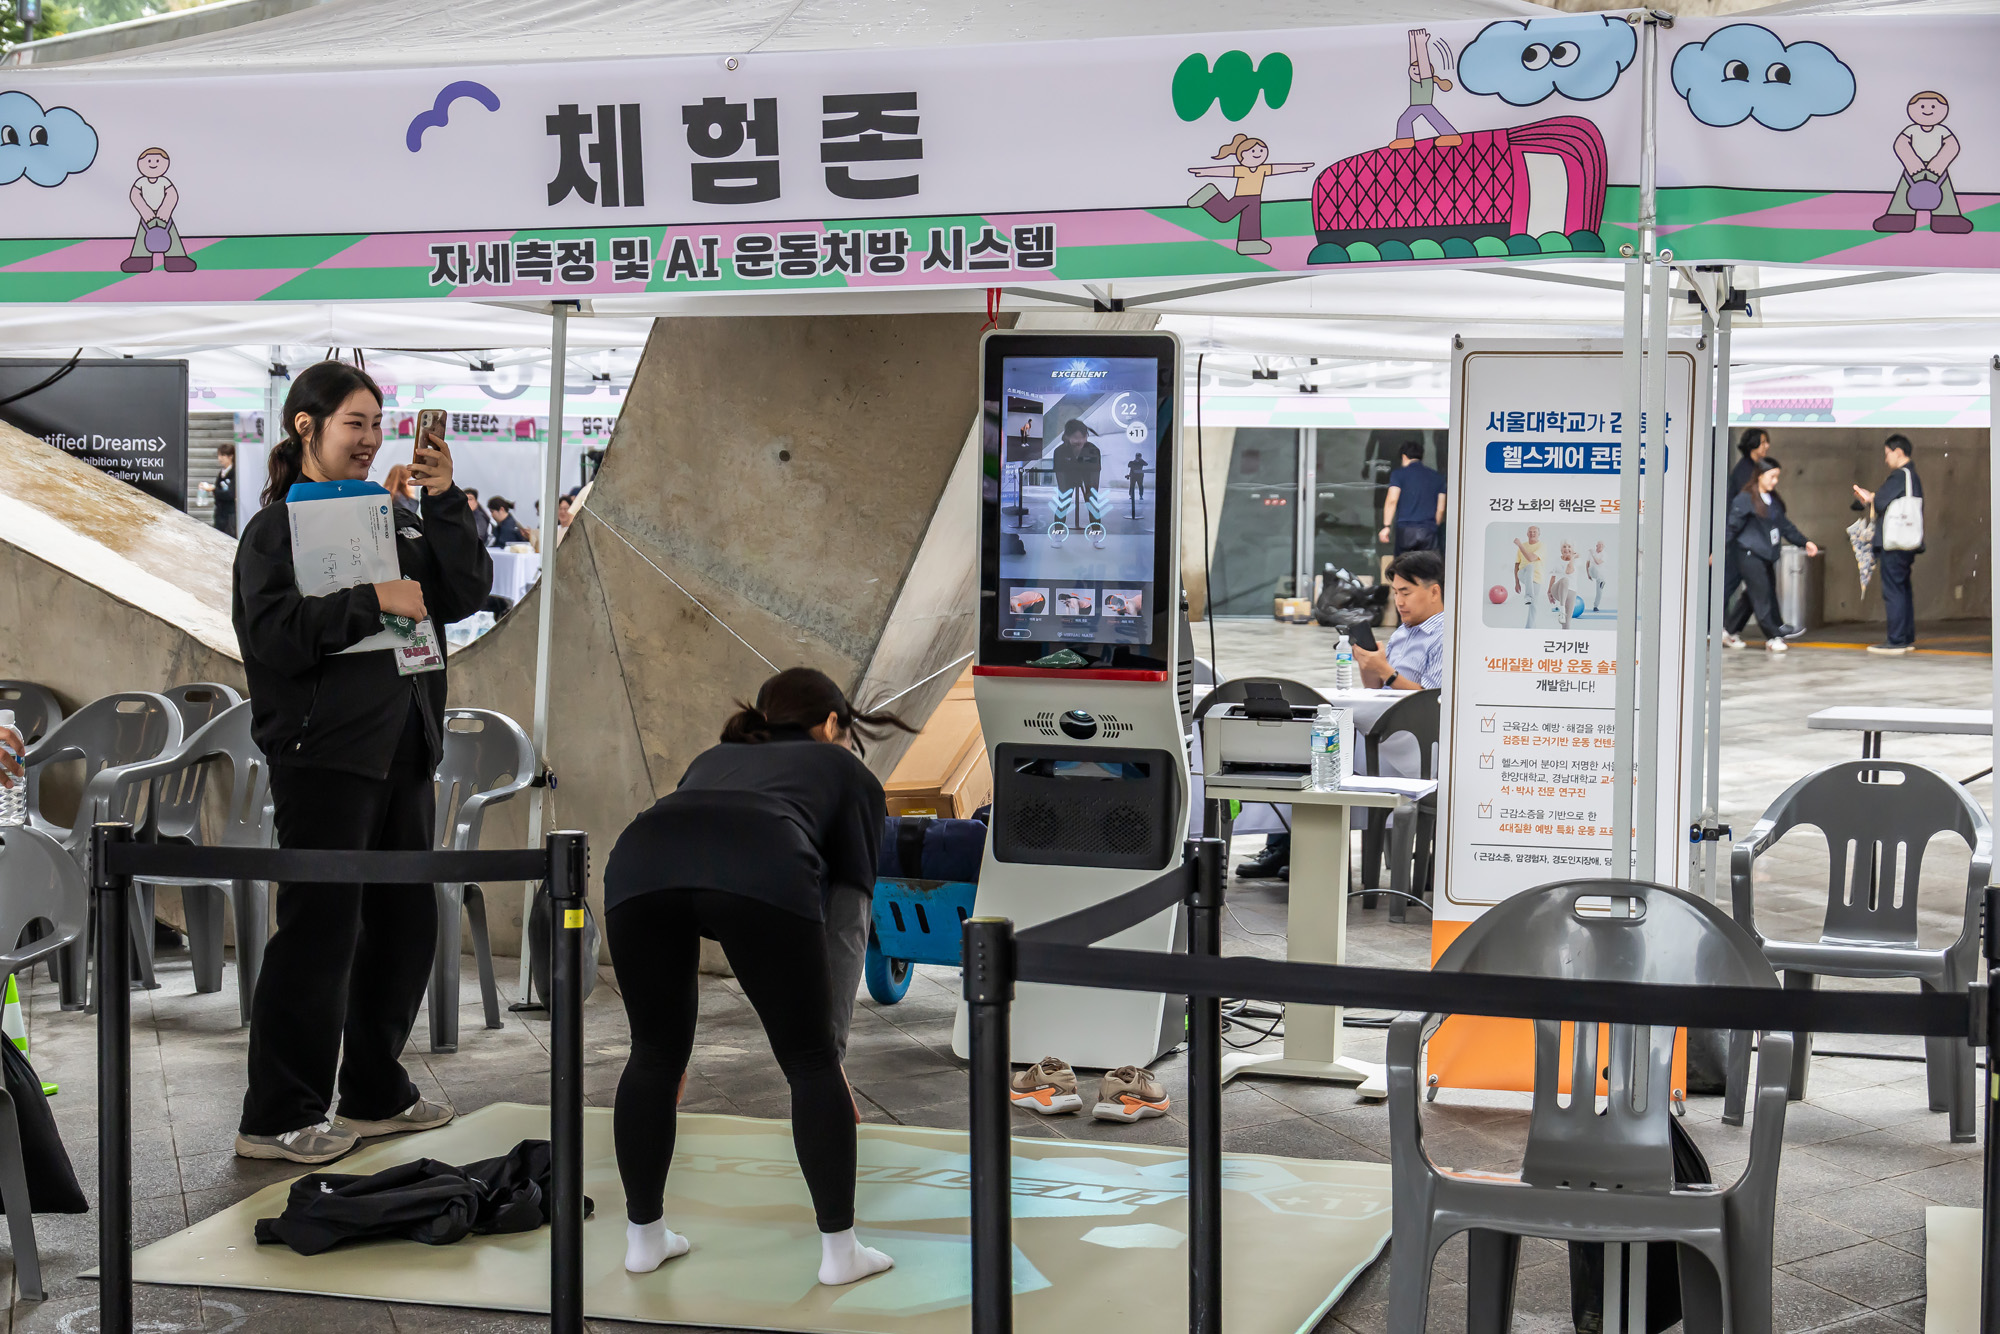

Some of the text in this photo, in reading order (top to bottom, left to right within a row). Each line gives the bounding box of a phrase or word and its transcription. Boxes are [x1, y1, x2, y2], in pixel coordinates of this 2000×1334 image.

[545, 91, 923, 208] 체험존
[431, 225, 1055, 284] 자세측정 및 AI 운동처방 시스템
[1121, 404, 1137, 415] 22
[1486, 411, 1605, 433] 서울대학교가
[39, 434, 87, 449] tified
[121, 458, 133, 469] by
[135, 458, 164, 467] YEKKI
[1503, 446, 1584, 469] 헬스케어
[142, 471, 164, 480] Mun
[1489, 498, 1514, 511] 건강
[1517, 499, 1554, 512] 노화의
[1559, 499, 1596, 512] 핵심은
[350, 537, 361, 566] 2025
[1543, 640, 1589, 653] 근거기반
[1537, 658, 1563, 673] 예방
[1567, 659, 1593, 674] 운동
[1536, 679, 1595, 693] 개발합니다!
[1502, 721, 1539, 732] 근육감소
[1597, 724, 1615, 735] 위한
[1503, 735, 1530, 745] 검증된
[1532, 736, 1569, 747] 근거기반
[1572, 737, 1590, 748] 운동
[1501, 758, 1538, 769] 헬스케어
[1541, 759, 1568, 770] 분야의
[1571, 760, 1598, 771] 저명한
[1501, 771, 1549, 783] 한양대학교,
[1552, 773, 1597, 784] 경남대학교
[1537, 786, 1555, 797] 전문
[1559, 787, 1586, 798] 연구진
[1500, 808, 1597, 821] 근감소증을 기반으로 한
[1499, 823, 1532, 834] 4대질환
[1535, 824, 1553, 834] 예방
[1556, 825, 1574, 835] 특화
[1578, 826, 1596, 836] 운동
